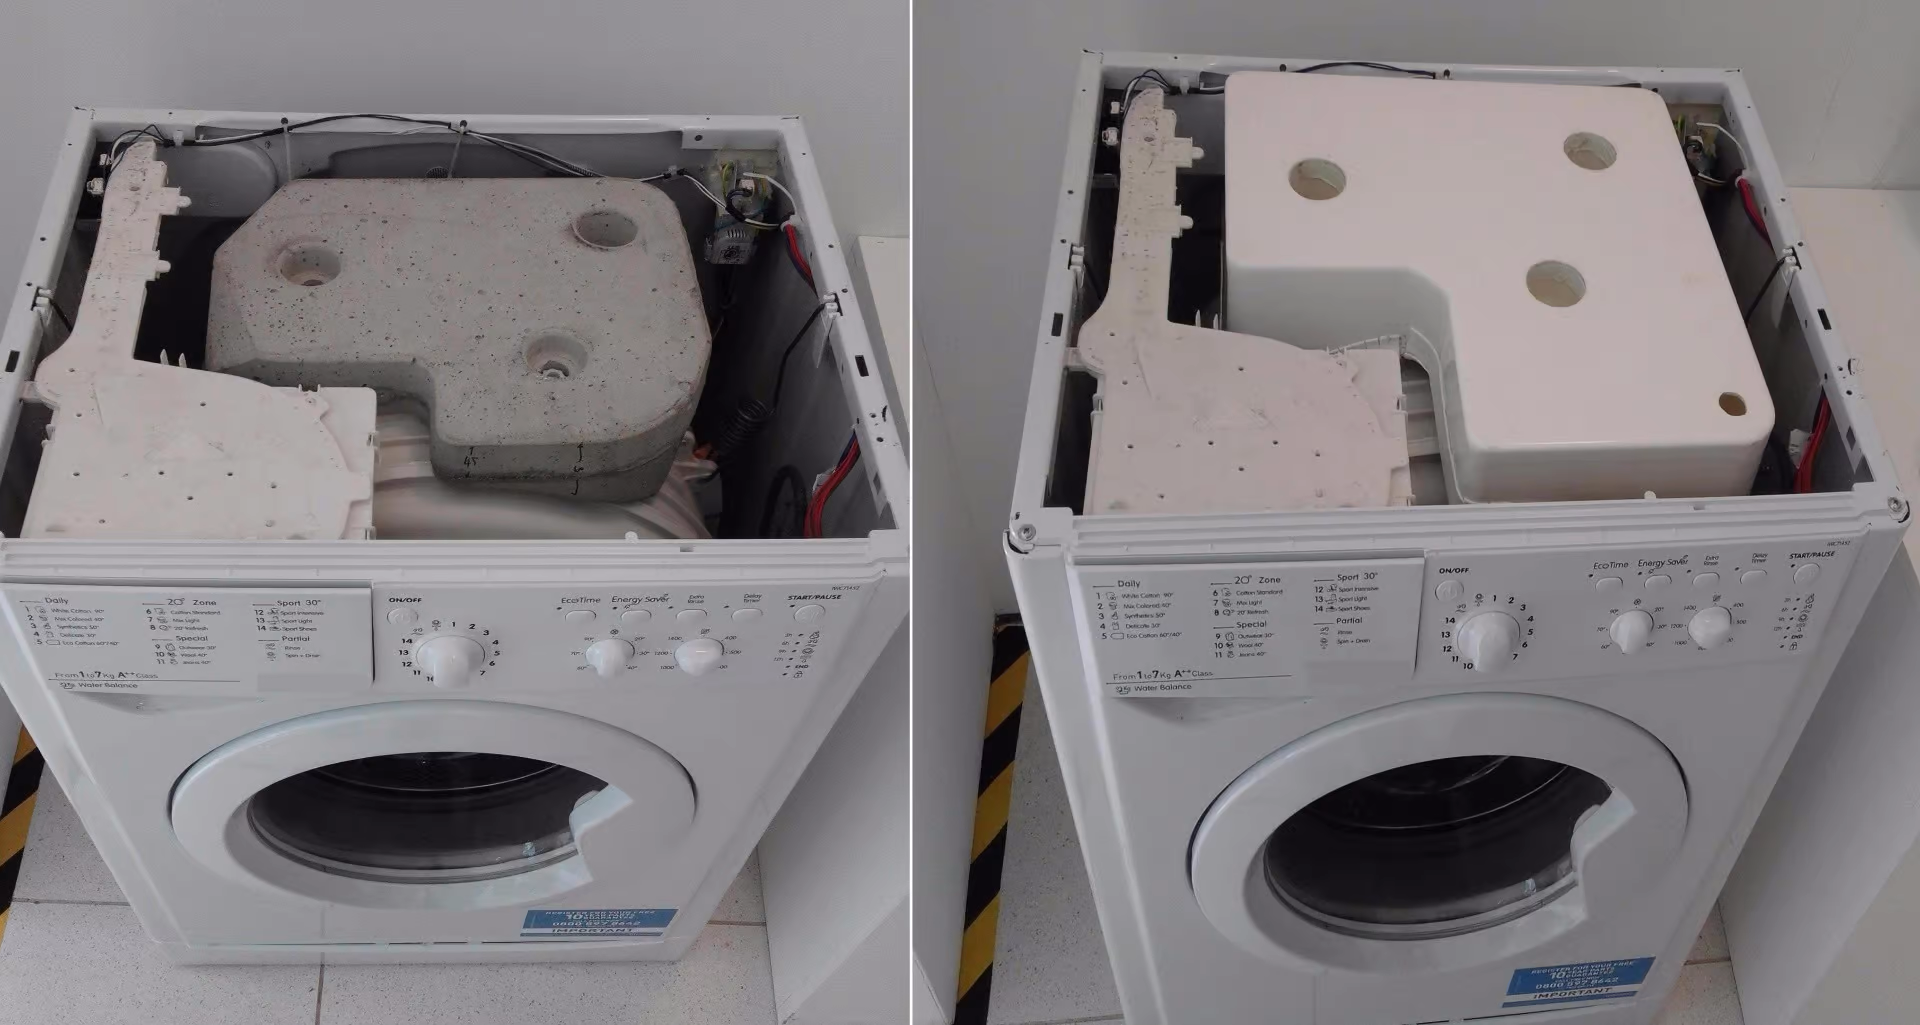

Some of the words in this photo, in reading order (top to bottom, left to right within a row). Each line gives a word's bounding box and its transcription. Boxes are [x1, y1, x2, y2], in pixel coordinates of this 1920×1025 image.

[1789, 551, 1835, 559] START/PAUSE
[1638, 559, 1665, 570] Energy
[1667, 558, 1689, 566] Saver
[1259, 576, 1281, 584] Zone
[1337, 574, 1359, 582] Sport
[1363, 572, 1379, 580] 30°
[1117, 580, 1140, 588] Daily
[1213, 589, 1219, 597] 6
[611, 595, 642, 606] Energy
[645, 594, 670, 603] Saver
[1508, 596, 1514, 604] 2
[1097, 602, 1103, 610] 2
[1519, 603, 1526, 611] 3
[1098, 612, 1104, 620] 3
[1236, 621, 1267, 629] Special
[1101, 632, 1107, 640] 5
[1527, 628, 1534, 636] 5
[1214, 642, 1223, 650] 10
[1463, 662, 1474, 670] 10
[1113, 673, 1136, 681] From
[1136, 671, 1142, 679] 1
[1152, 670, 1159, 678] 7
[1160, 671, 1171, 679] Kg
[1191, 669, 1214, 677] Class
[1550, 971, 1567, 980] 10
[1535, 981, 1565, 990] 0800
[1533, 987, 1614, 999] IMPORTANT
